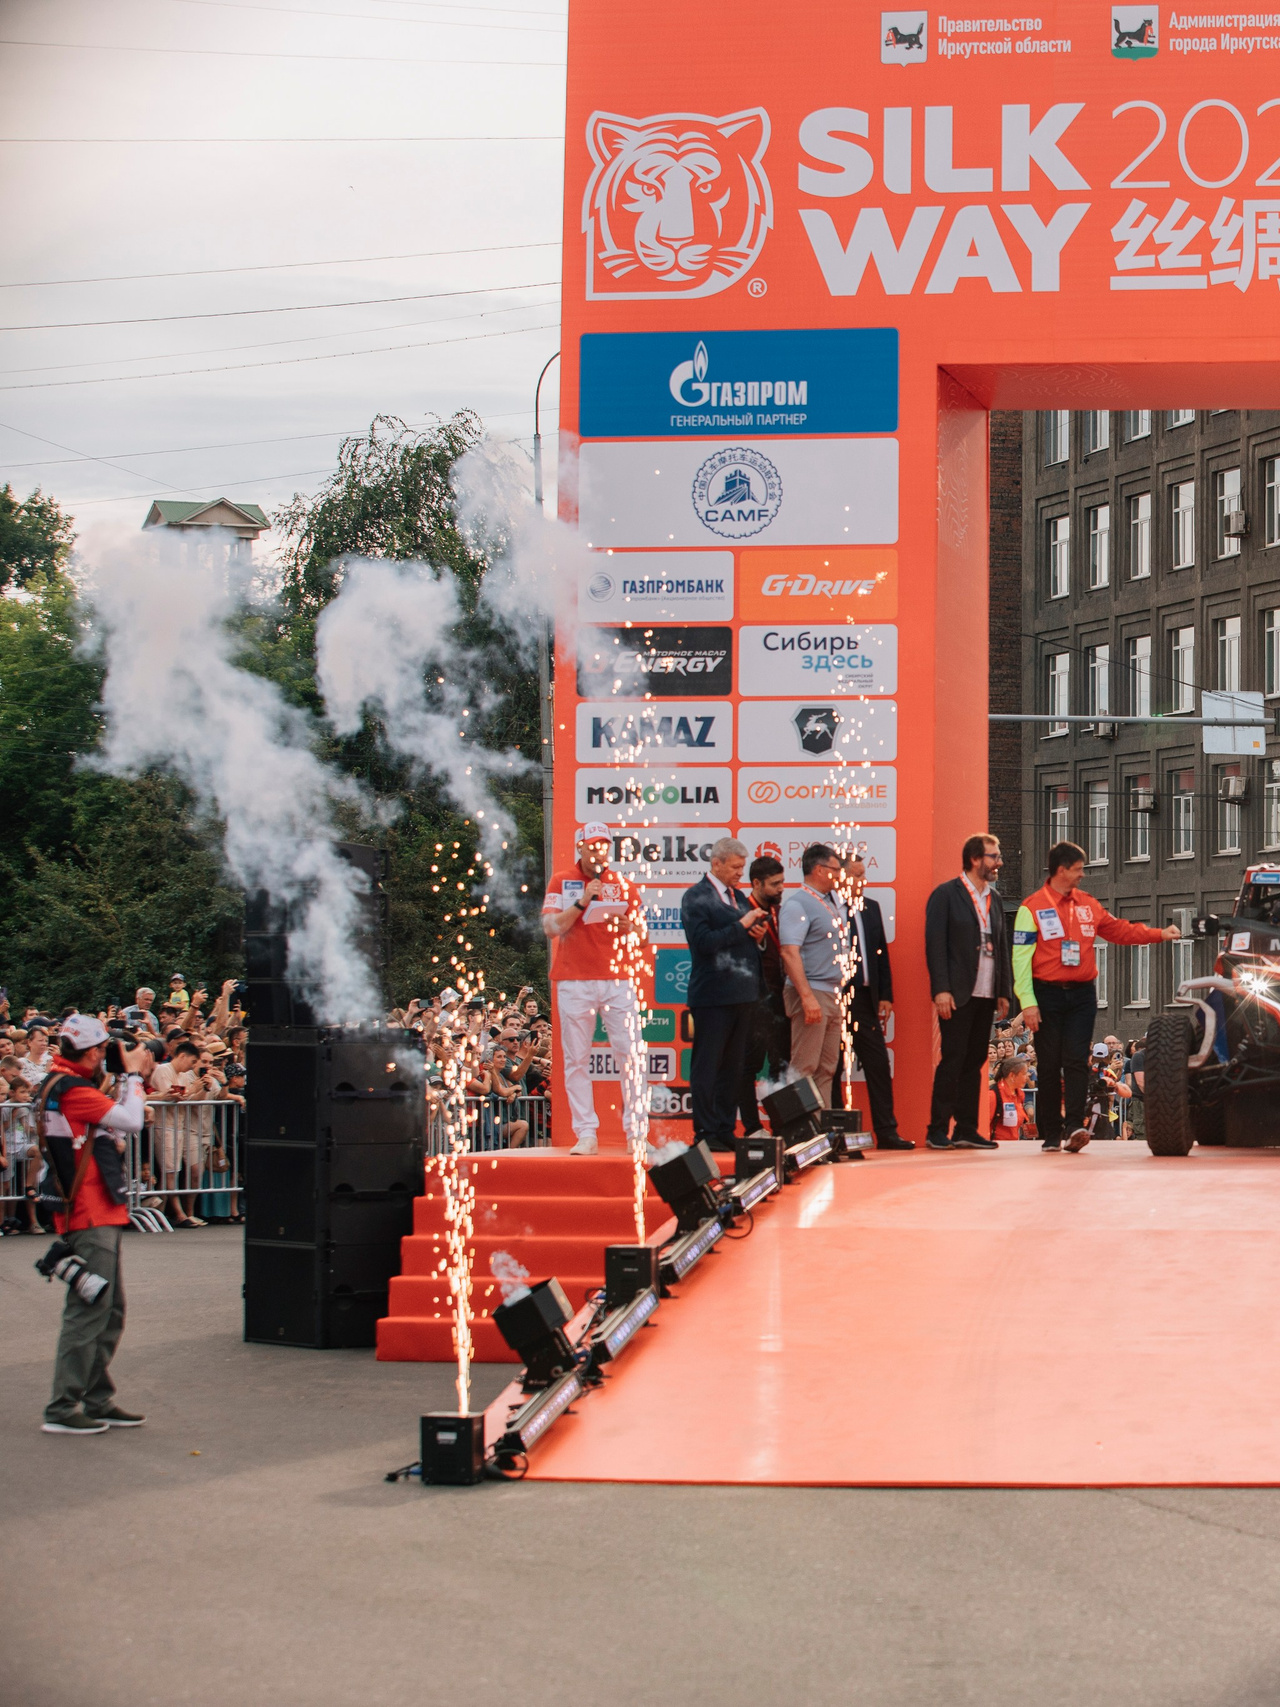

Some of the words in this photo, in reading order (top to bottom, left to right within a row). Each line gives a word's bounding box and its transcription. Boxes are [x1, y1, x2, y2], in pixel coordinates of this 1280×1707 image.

[938, 15, 1043, 35] Правительство
[1169, 11, 1280, 31] Администрация
[938, 36, 1011, 58] Иркутской
[1015, 36, 1072, 54] области
[1169, 35, 1217, 53] города
[799, 103, 1092, 198] SILK
[798, 203, 1092, 297] WAY
[711, 381, 808, 407] ГАЗПРОМ
[670, 412, 754, 427] ГЕНЕРАЛЬНЫЙ
[756, 413, 808, 427] ПАРТНЕР
[704, 508, 770, 523] CAMF
[622, 579, 725, 594] ГАЗПРОМБАНК
[763, 631, 859, 655] Сибирь
[801, 654, 874, 673] здесь
[592, 716, 716, 748] KAMAZ
[587, 786, 720, 805] MONGOLIA
[784, 785, 888, 799] СОГЛАСИЕ
